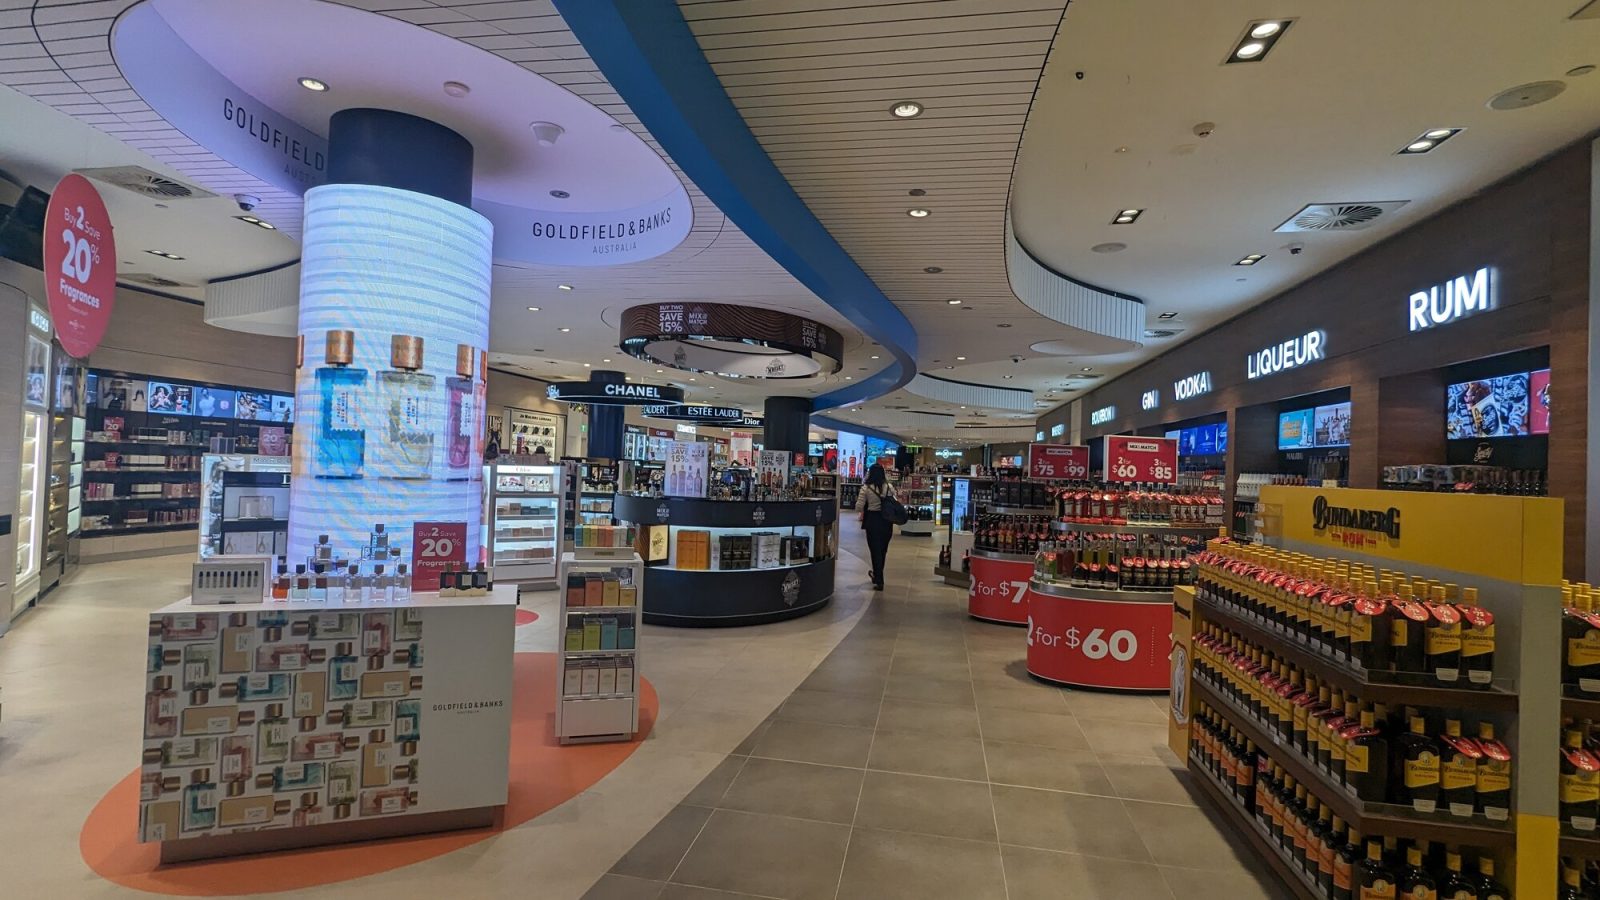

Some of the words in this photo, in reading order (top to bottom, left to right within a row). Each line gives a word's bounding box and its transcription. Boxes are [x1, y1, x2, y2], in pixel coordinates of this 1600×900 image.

[224, 98, 325, 171] GOLDFIELD
[64, 208, 76, 228] Buy
[76, 206, 85, 231] 2
[85, 221, 101, 241] Save
[592, 242, 637, 255] AUSTRALIA
[60, 279, 101, 308] Fragrances
[1409, 267, 1490, 332] RUM
[659, 312, 684, 322] SAVE
[659, 321, 683, 333] 15%
[802, 327, 817, 342] SAVE
[802, 335, 817, 349] 15%
[1247, 329, 1322, 380] LIQUEUR
[605, 383, 661, 399] CHANEL
[1175, 371, 1210, 401] VODKA
[1142, 390, 1158, 411] GIN
[714, 408, 740, 418] LAUDER
[744, 417, 760, 425] Dior
[264, 434, 277, 442] 20
[671, 455, 689, 463] 15%
[1034, 465, 1054, 476] $75
[1063, 466, 1085, 477] $99
[1112, 465, 1136, 478] $60
[1149, 466, 1172, 479] $85
[1312, 495, 1401, 540] BUNDABERG
[432, 527, 439, 537] 2
[421, 538, 461, 557] 20%
[979, 581, 996, 597] for
[1036, 627, 1061, 647] for
[1065, 626, 1138, 662] $60
